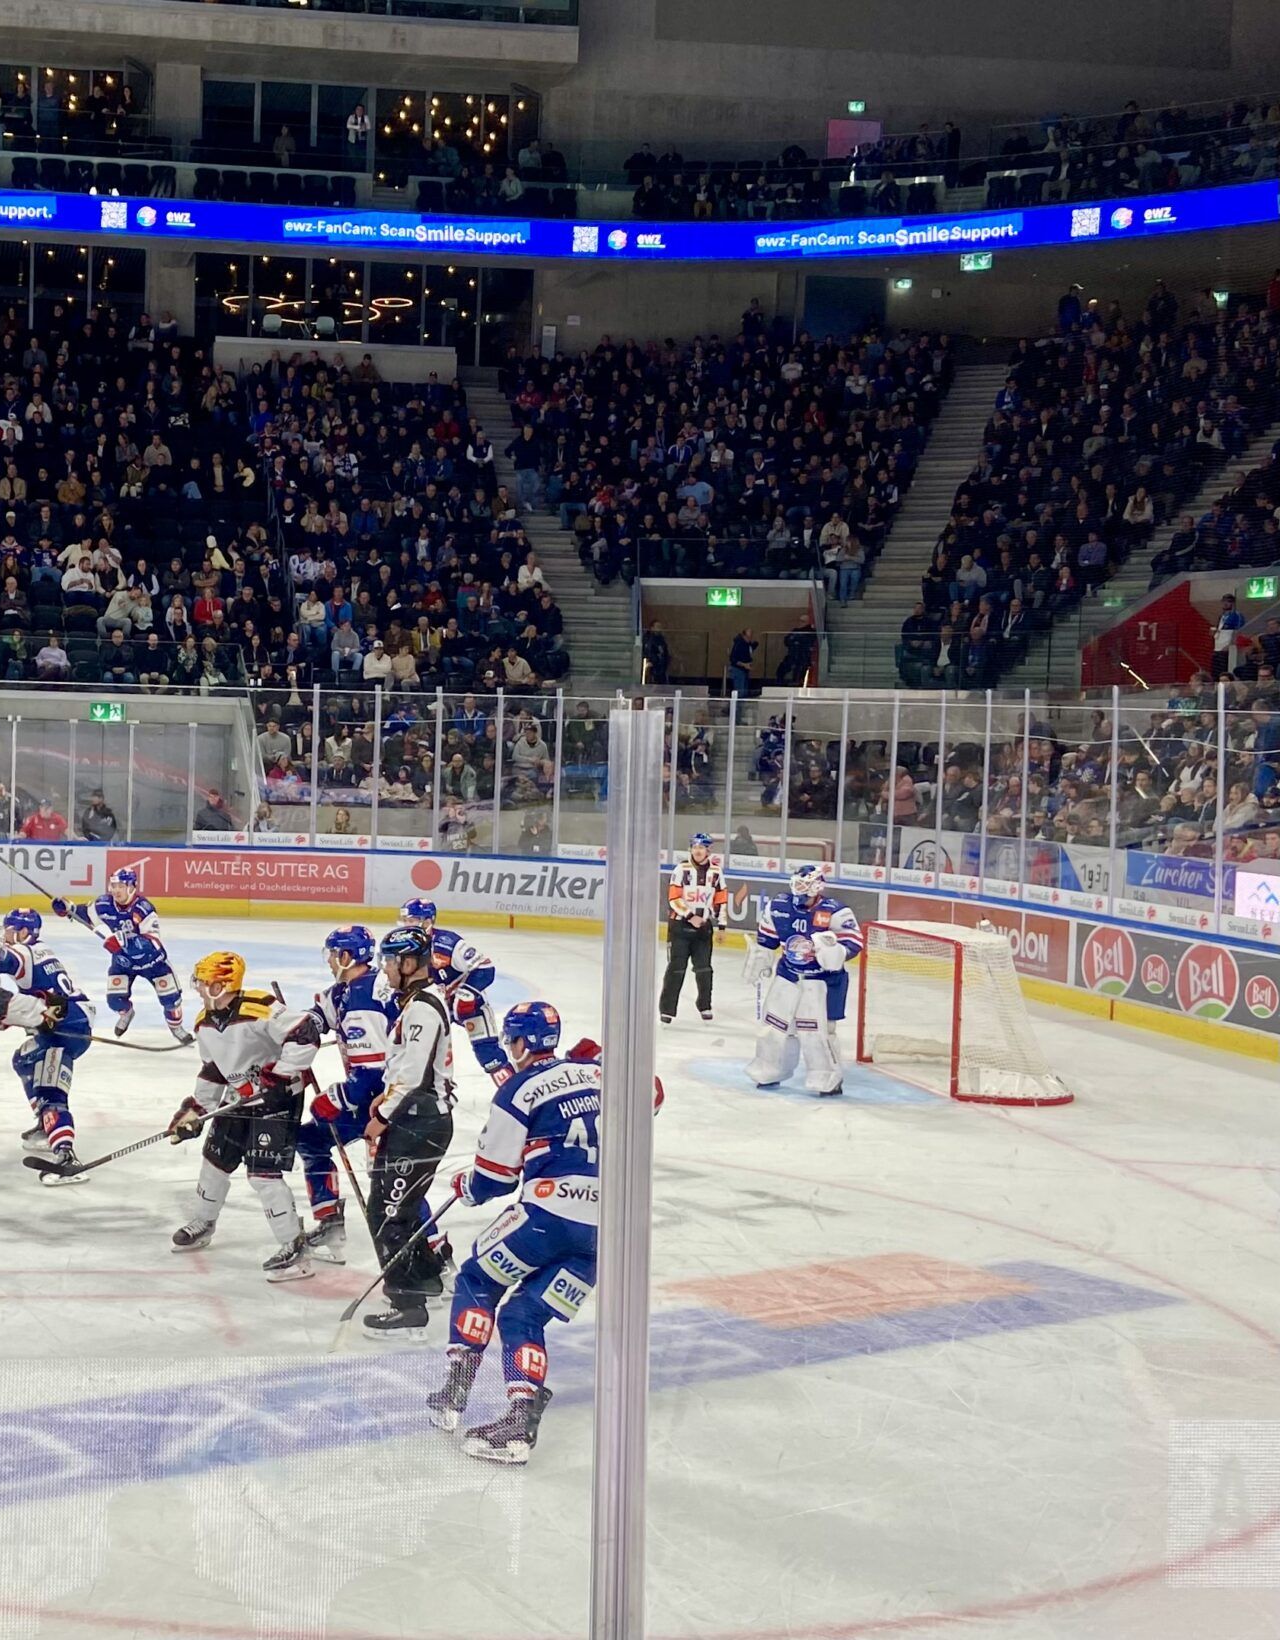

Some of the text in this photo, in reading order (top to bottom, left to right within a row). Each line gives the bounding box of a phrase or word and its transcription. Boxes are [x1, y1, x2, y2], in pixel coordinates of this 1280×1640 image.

[166, 211, 191, 223] ewz
[1144, 207, 1171, 220] ewz
[285, 221, 376, 236] ewz-FanCam:
[757, 233, 854, 247] ewz-FanCam:
[257, 835, 292, 844] SwissLife
[319, 837, 354, 846] SwissLife
[185, 860, 349, 880] WALTER SUTTER AG
[183, 881, 348, 895] Kaminfeger- und Dachdeckergeschäft
[448, 860, 604, 900] hunziker
[687, 890, 712, 904] sky
[494, 900, 533, 912] Technik
[534, 902, 549, 913] im
[792, 918, 808, 933] 40
[1092, 936, 1125, 980] Bell
[1146, 960, 1164, 982] Bell
[1188, 953, 1225, 1002] Bell
[1252, 981, 1272, 1007] Bell
[523, 1068, 596, 1108] SwissLife
[563, 1117, 600, 1164] 4
[491, 1249, 526, 1280] ewz
[554, 1277, 586, 1306] ewz
